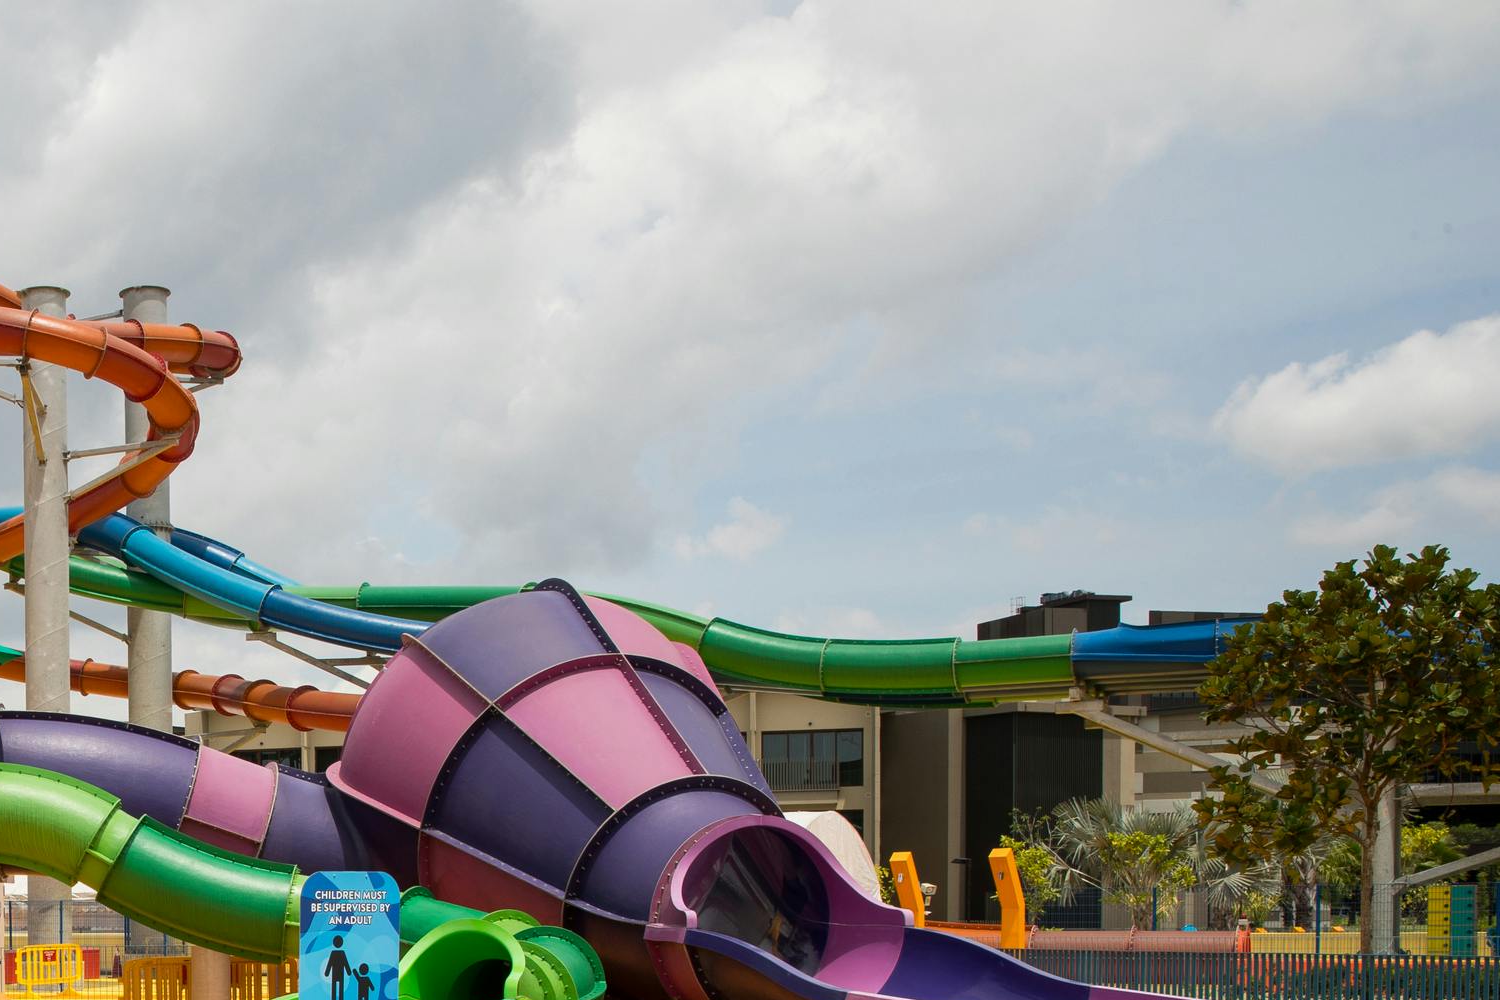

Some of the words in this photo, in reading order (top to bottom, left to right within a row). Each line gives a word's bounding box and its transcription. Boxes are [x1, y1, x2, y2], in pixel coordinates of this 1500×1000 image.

[315, 891, 361, 900] CHILDREN
[363, 891, 387, 900] MUST
[311, 903, 322, 912] BE
[324, 903, 377, 912] SUPERVISED
[380, 903, 391, 912] BY
[329, 916, 342, 925] AN
[344, 916, 372, 925] ADULT
